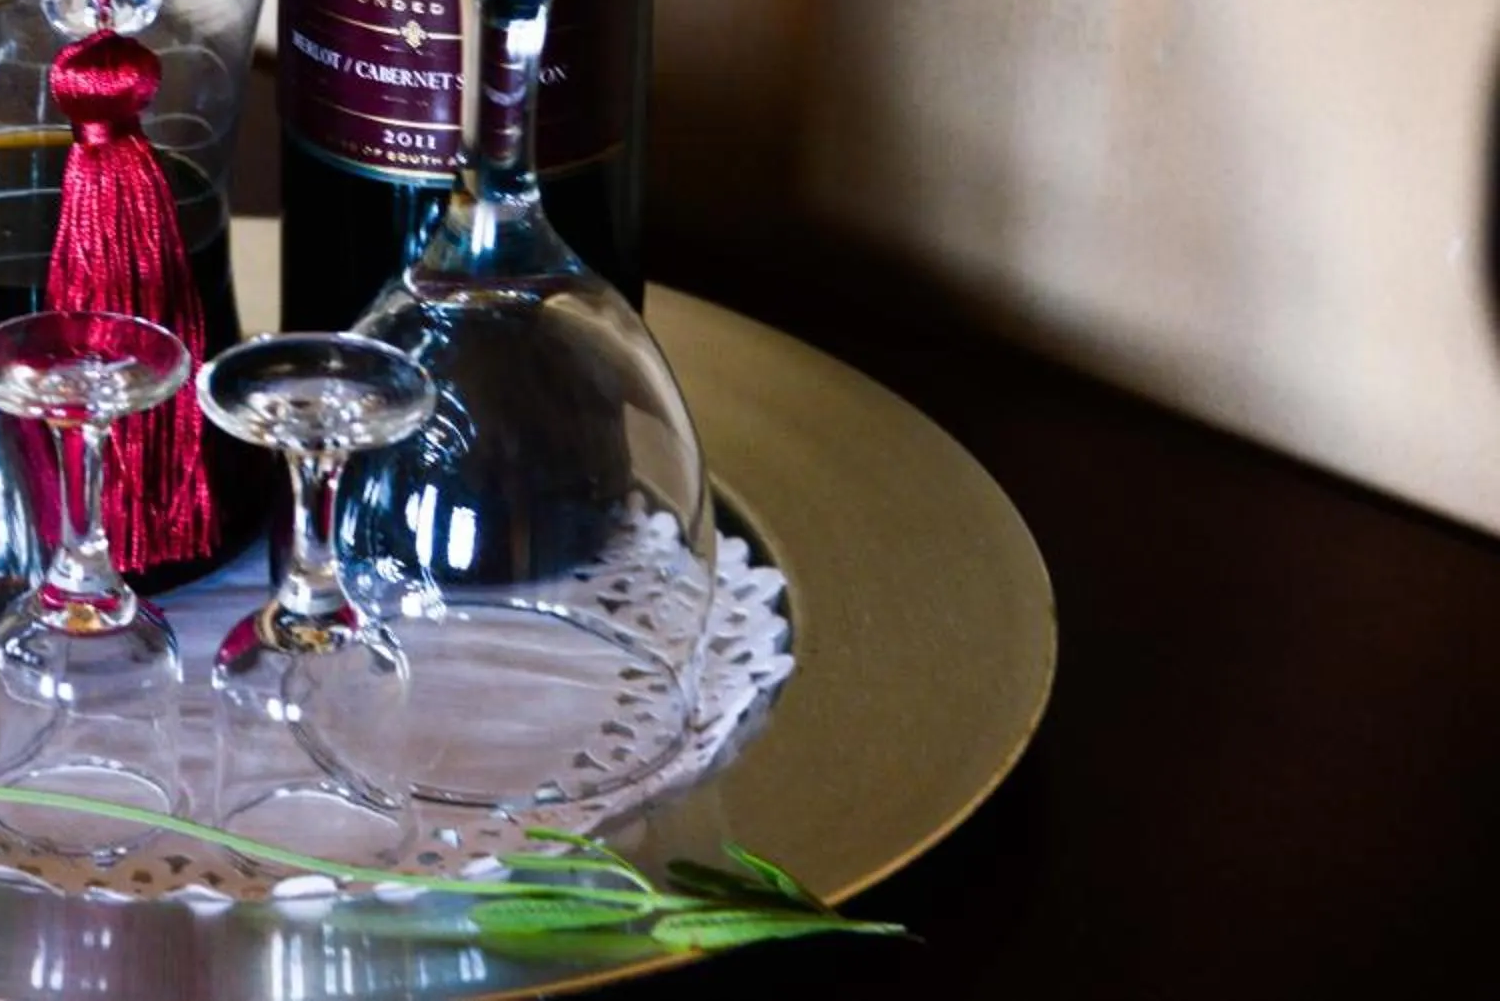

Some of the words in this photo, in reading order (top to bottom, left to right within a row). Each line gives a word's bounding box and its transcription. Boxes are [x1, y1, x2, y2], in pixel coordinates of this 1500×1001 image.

[355, 60, 453, 91] CABERNET
[383, 129, 437, 150] 2011
[387, 151, 443, 167] SOUTH
